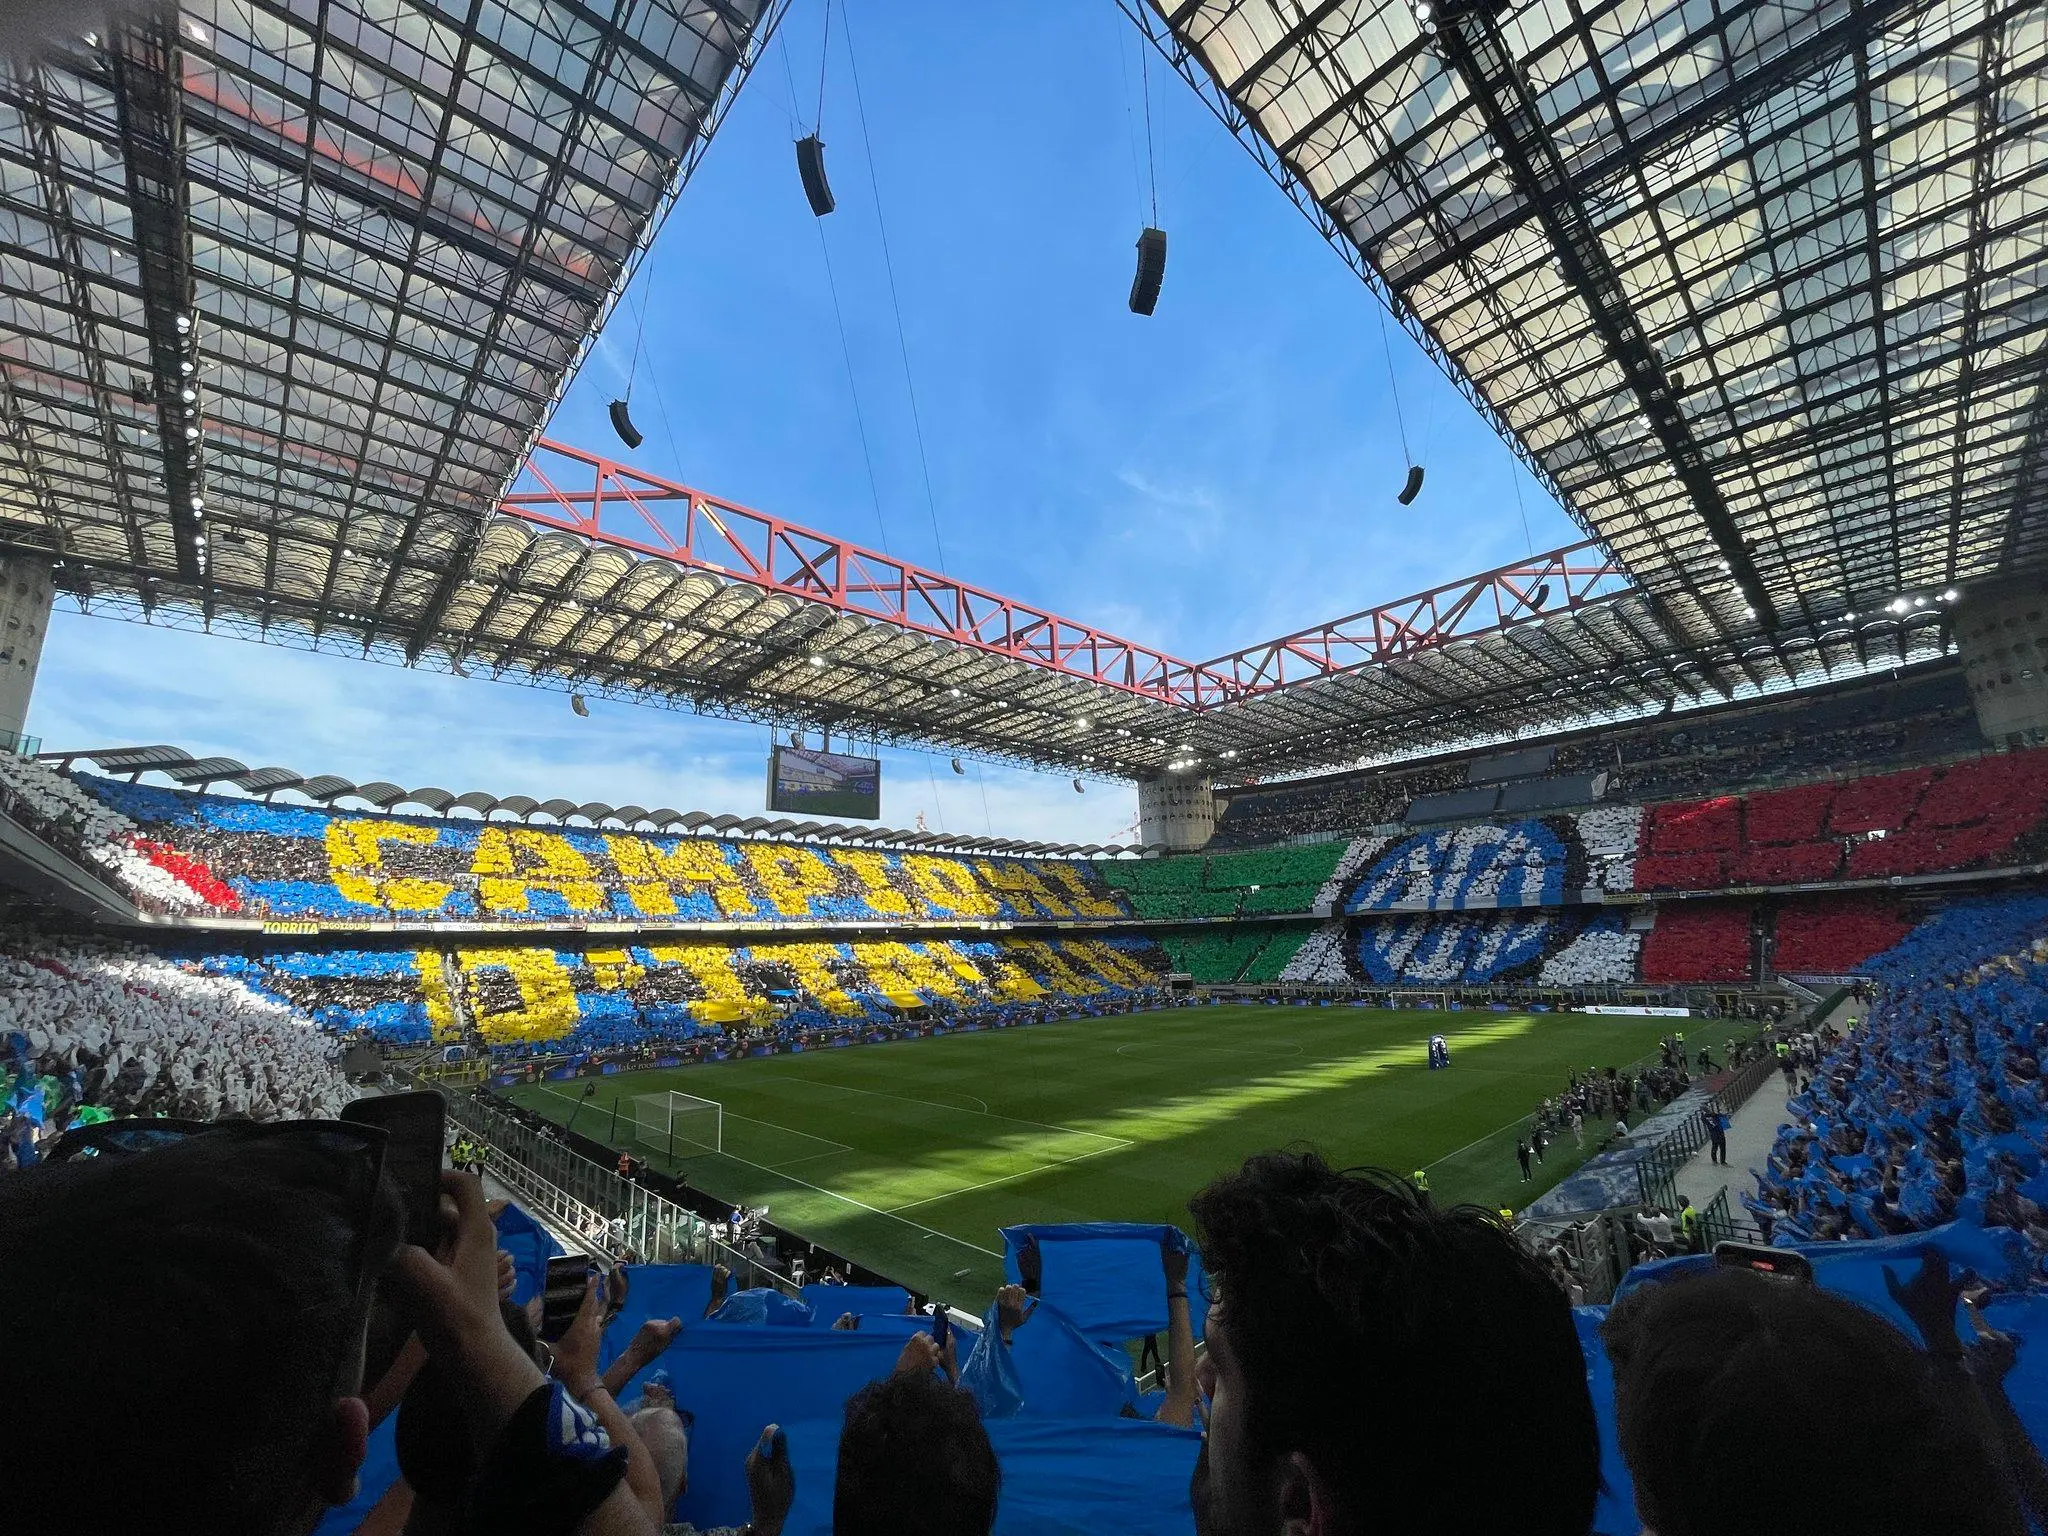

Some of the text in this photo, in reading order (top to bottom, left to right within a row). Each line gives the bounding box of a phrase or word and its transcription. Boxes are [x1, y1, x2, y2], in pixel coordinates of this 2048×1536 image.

[263, 922, 319, 934] TORRITA
[613, 1062, 636, 1072] Make
[638, 1061, 660, 1069] room
